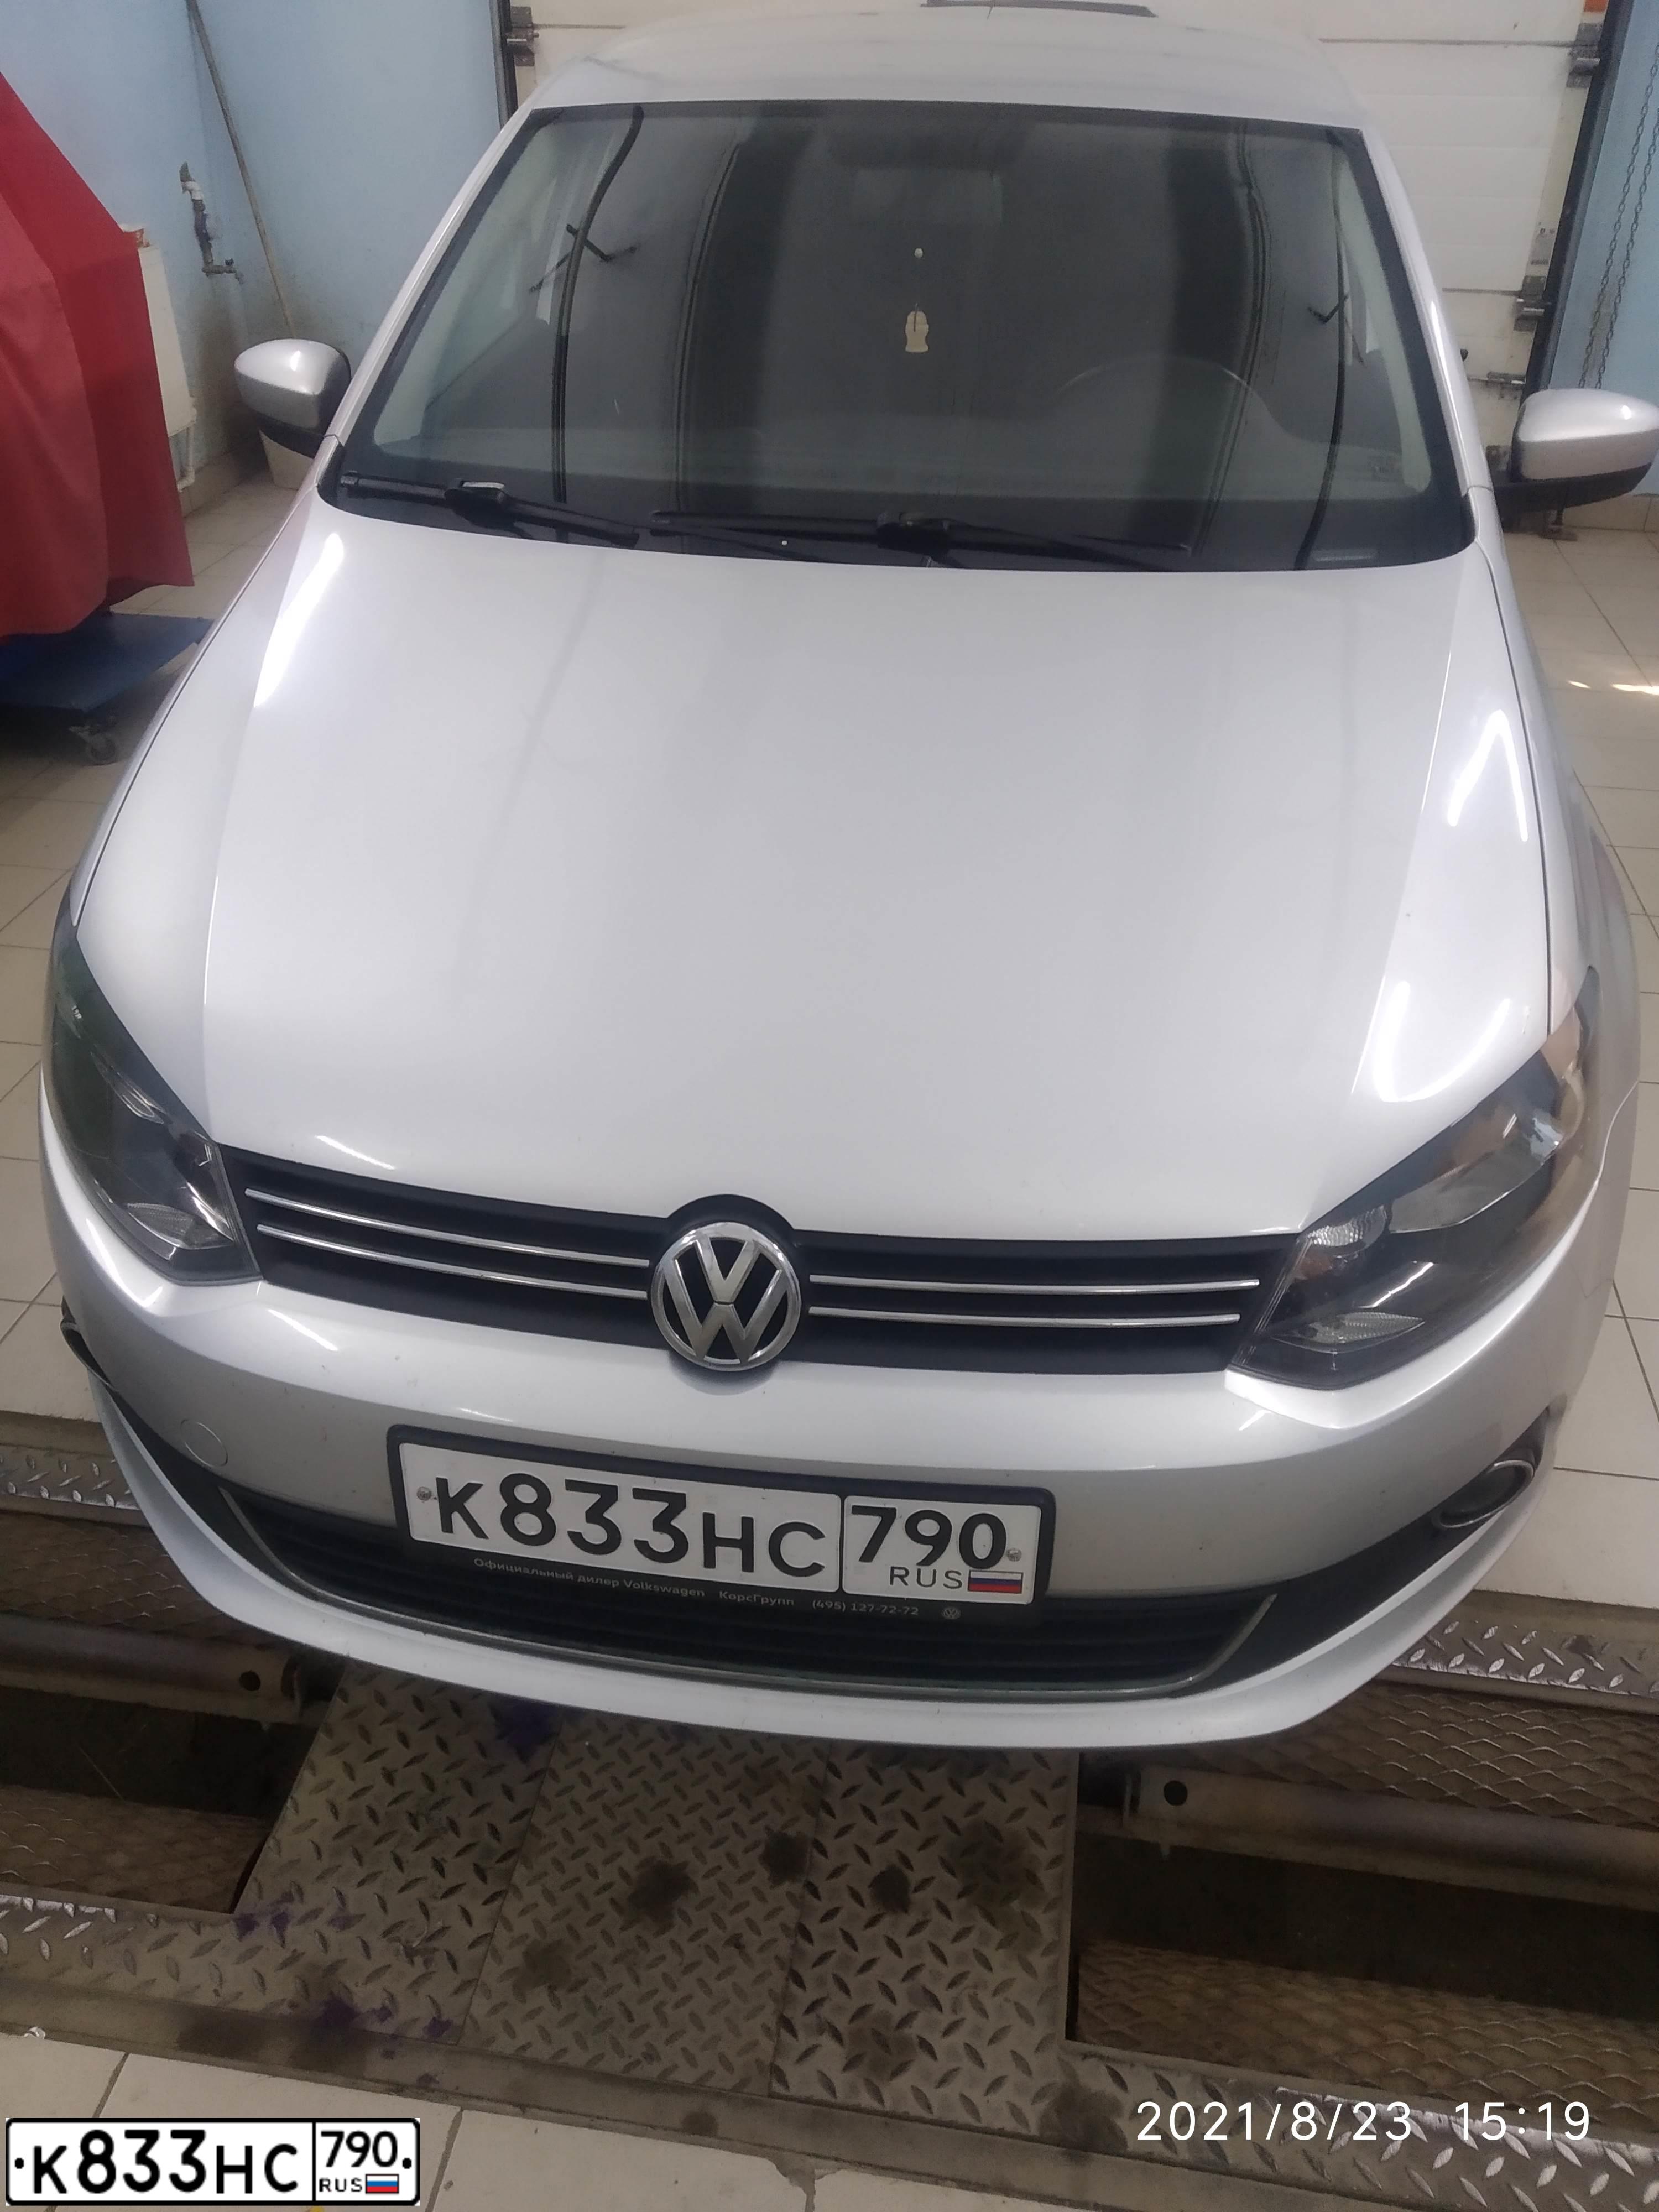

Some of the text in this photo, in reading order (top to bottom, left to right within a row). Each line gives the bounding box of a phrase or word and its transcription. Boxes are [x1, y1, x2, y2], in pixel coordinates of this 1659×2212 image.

[435, 1472, 1007, 1578] К833НС 790
[473, 1558, 573, 1580] Официальный
[577, 1574, 620, 1588] дилер
[623, 1579, 706, 1598] Volkswagen
[718, 1590, 795, 1606] КорсГрупп
[812, 1599, 846, 1611] (495)
[889, 1566, 963, 1590] RUS
